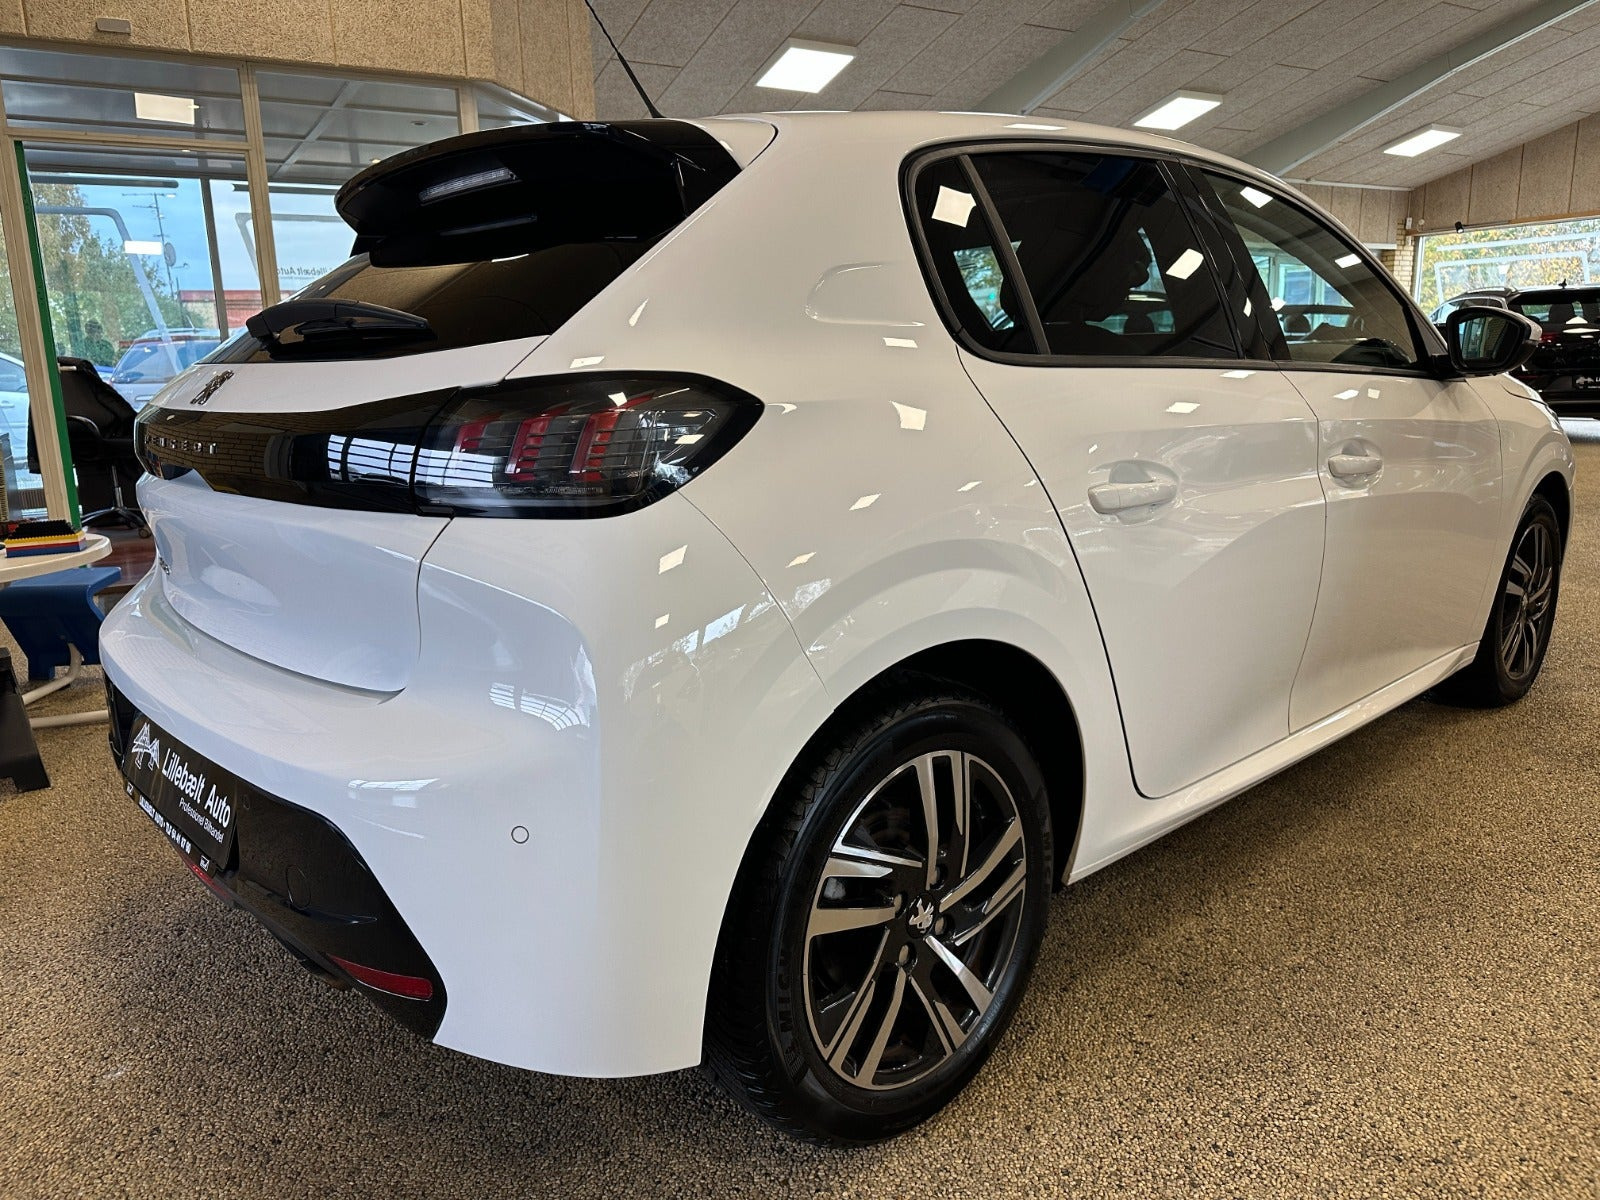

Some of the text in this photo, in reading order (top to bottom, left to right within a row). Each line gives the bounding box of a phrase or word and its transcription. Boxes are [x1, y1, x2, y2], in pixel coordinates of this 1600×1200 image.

[144, 433, 218, 454] PEUGEOT
[161, 747, 231, 828] Lillebælt Auto
